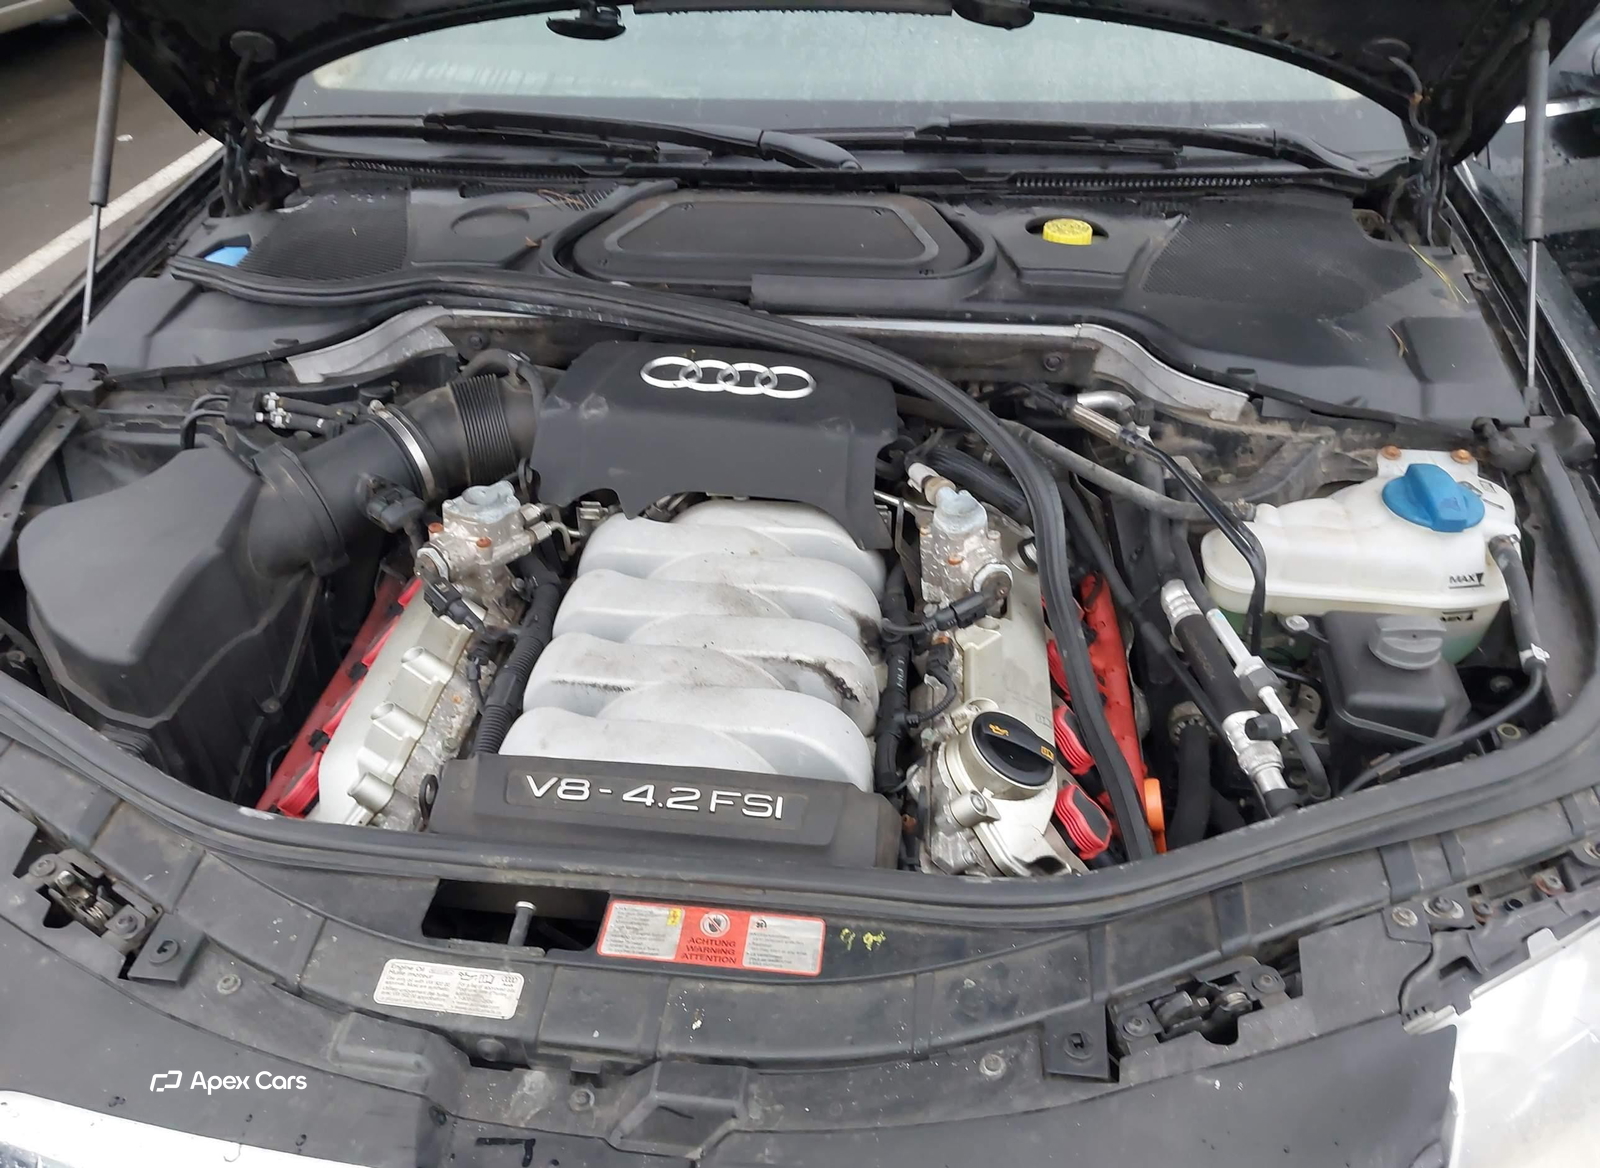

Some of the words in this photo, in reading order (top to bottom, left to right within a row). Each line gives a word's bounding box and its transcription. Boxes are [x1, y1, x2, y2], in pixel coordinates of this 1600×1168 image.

[1449, 574, 1475, 583] MAX
[526, 775, 591, 801] V8
[622, 784, 702, 811] 4.2
[709, 790, 784, 819] FSI
[687, 936, 736, 948] ACHTUNG
[685, 944, 736, 956] WARNING
[681, 952, 737, 965] ATTENTION
